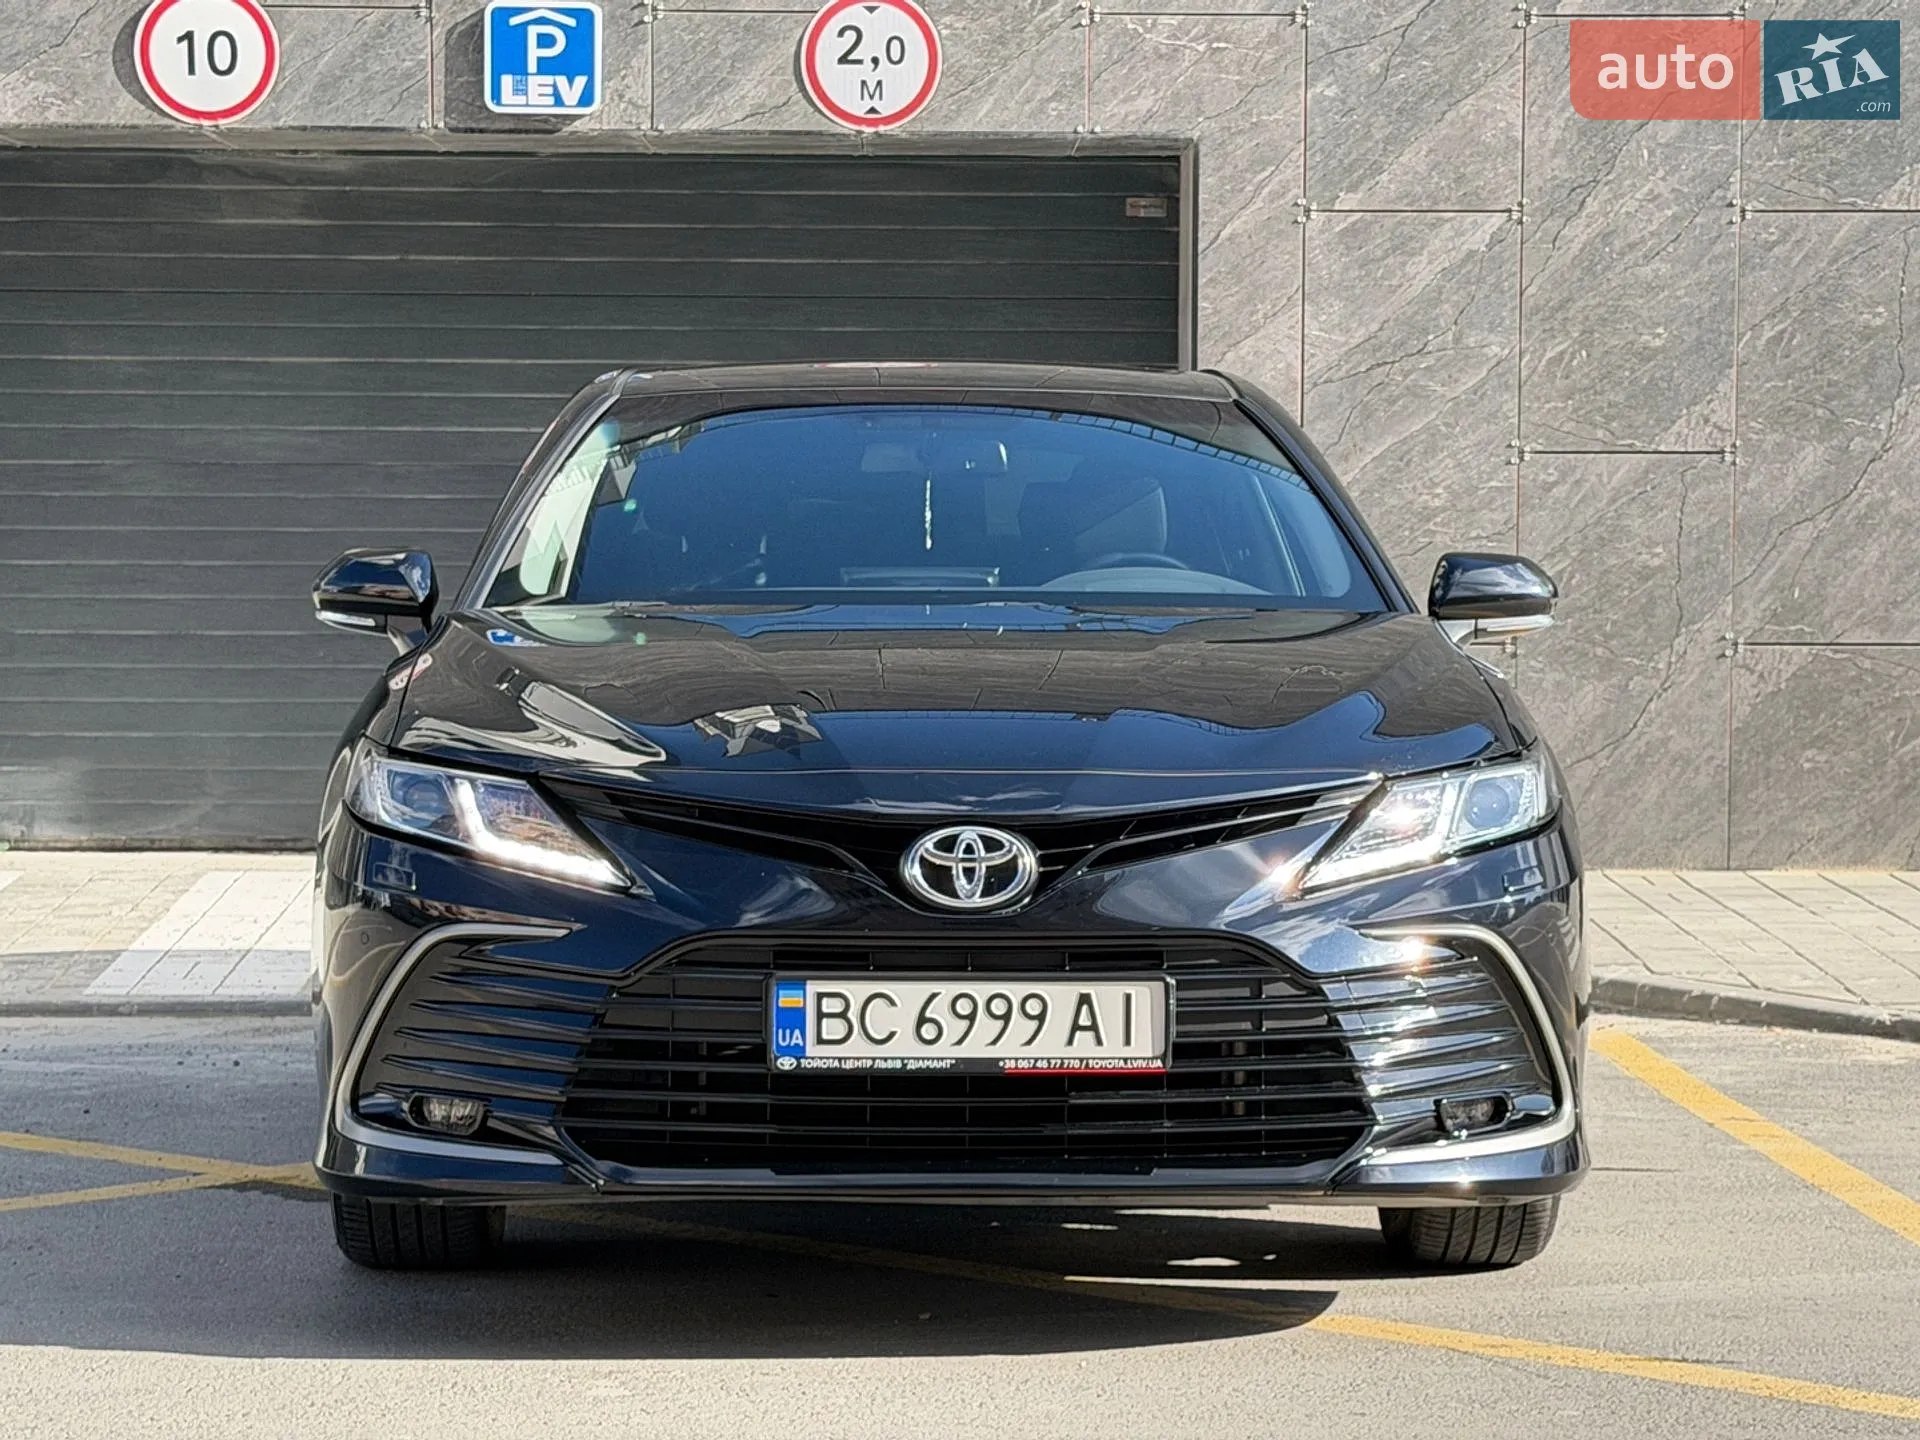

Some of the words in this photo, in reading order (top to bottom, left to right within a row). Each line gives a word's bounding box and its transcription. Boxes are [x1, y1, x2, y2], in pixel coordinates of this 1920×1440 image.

[176, 30, 238, 76] 10
[527, 24, 566, 73] P
[836, 24, 906, 72] 2,0
[500, 74, 589, 105] LEV
[778, 1028, 804, 1047] UA
[815, 991, 899, 1046] BC
[915, 991, 1048, 1046] 6999
[800, 1058, 840, 1069] ТОЙОТА
[841, 1059, 872, 1069] ЦЕНТР
[873, 1059, 902, 1069] ЛЬВІВ
